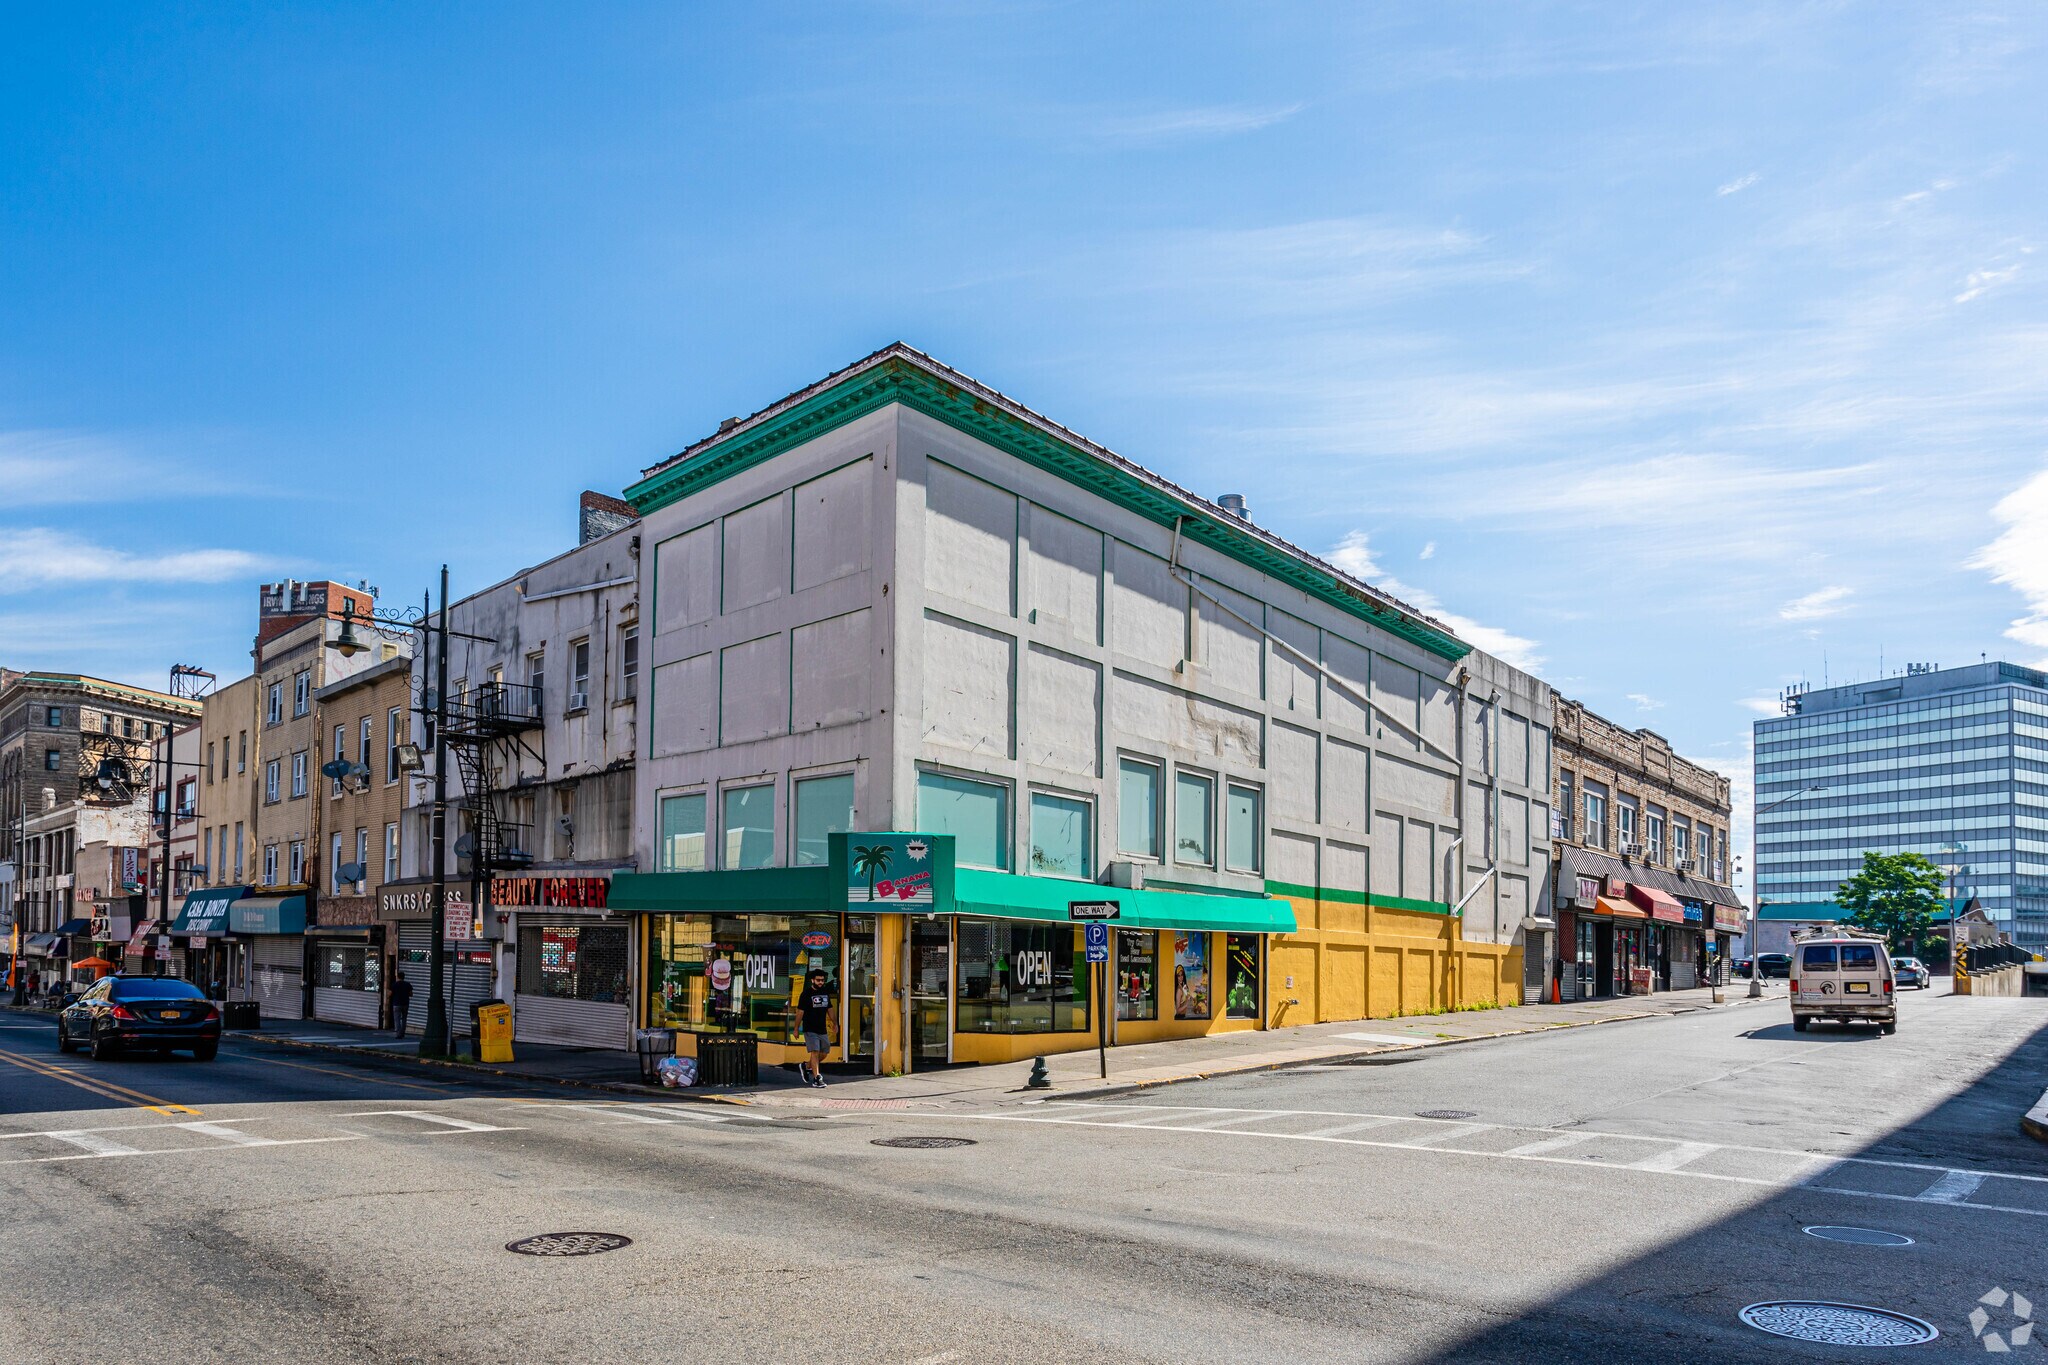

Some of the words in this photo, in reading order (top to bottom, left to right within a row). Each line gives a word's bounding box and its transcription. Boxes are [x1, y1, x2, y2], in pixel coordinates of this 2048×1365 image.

[125, 849, 135, 877] PIZZA
[491, 877, 536, 905] BEAUTY
[543, 877, 606, 907] FOREVER
[876, 871, 930, 897] BANANA
[897, 882, 930, 900] KING
[186, 900, 204, 918] CASA
[202, 898, 230, 918] BONITA
[1075, 906, 1090, 915] ONE
[1090, 906, 1106, 914] WAY
[802, 935, 832, 946] OPEN
[1092, 927, 1102, 943] P
[745, 953, 776, 989] OPEN
[1017, 950, 1052, 986] OPEN
